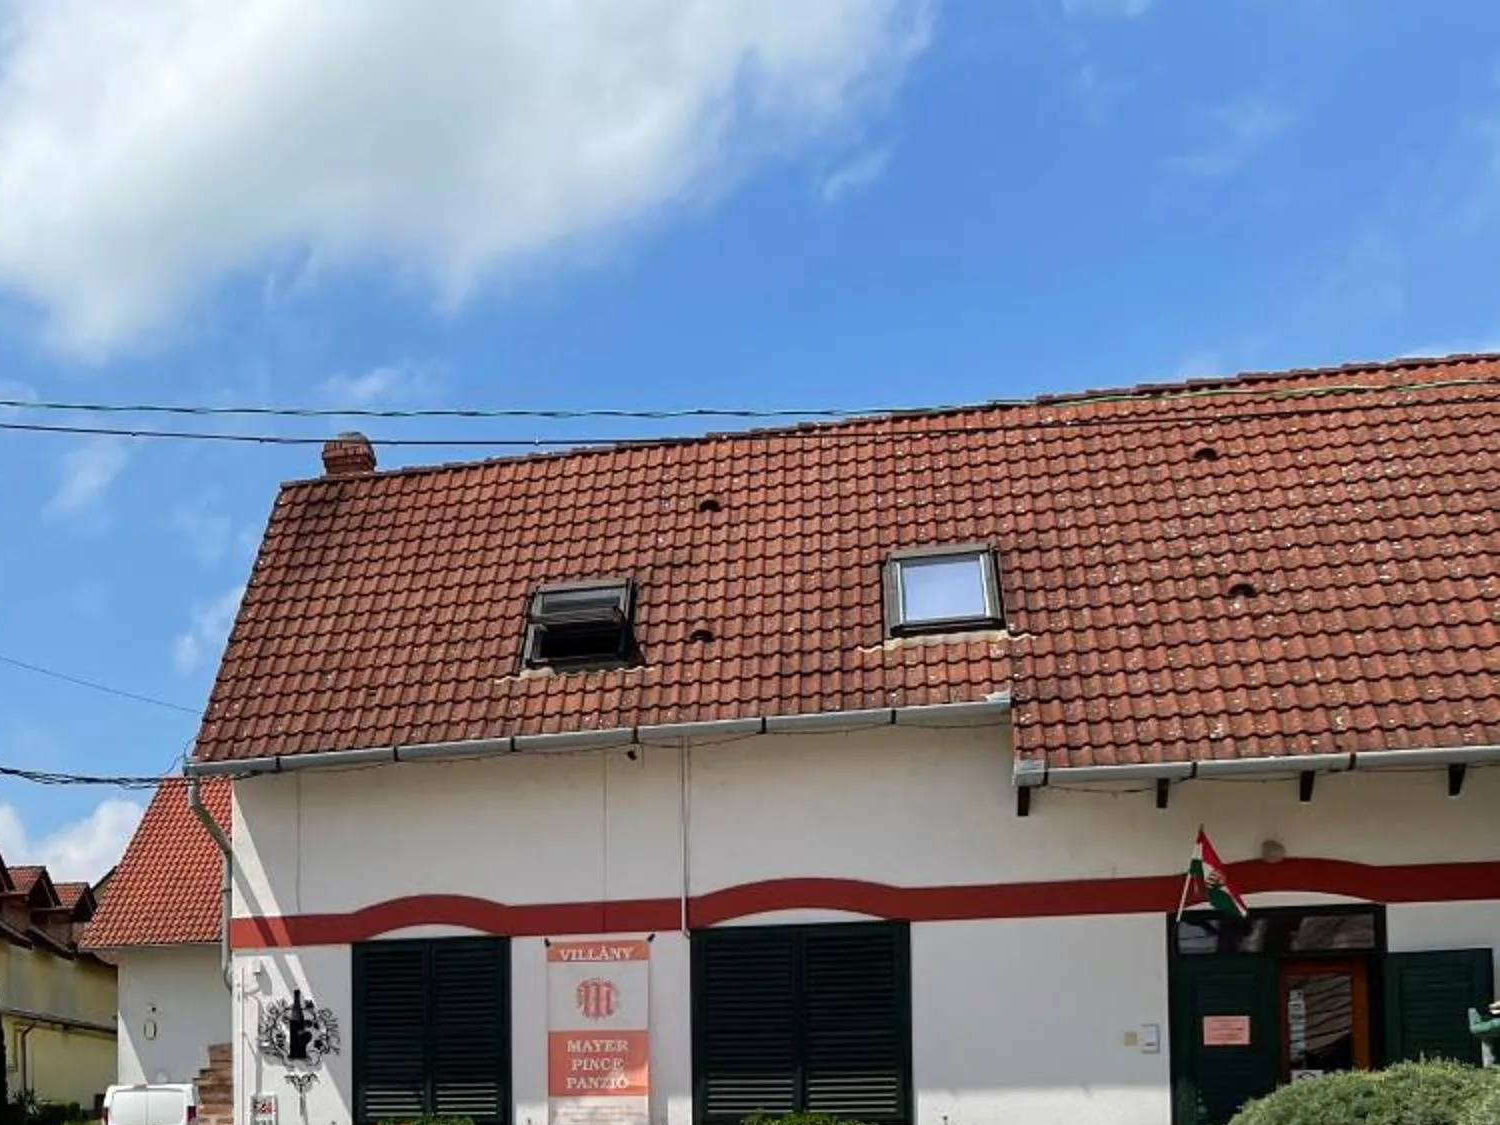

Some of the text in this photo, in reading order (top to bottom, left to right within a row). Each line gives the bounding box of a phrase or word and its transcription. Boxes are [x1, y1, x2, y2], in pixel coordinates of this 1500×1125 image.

[560, 945, 634, 961] VILLÁNY
[566, 1039, 629, 1053] MAYER
[571, 1057, 624, 1071] PINCE
[566, 1073, 629, 1089] PANZIÓ
